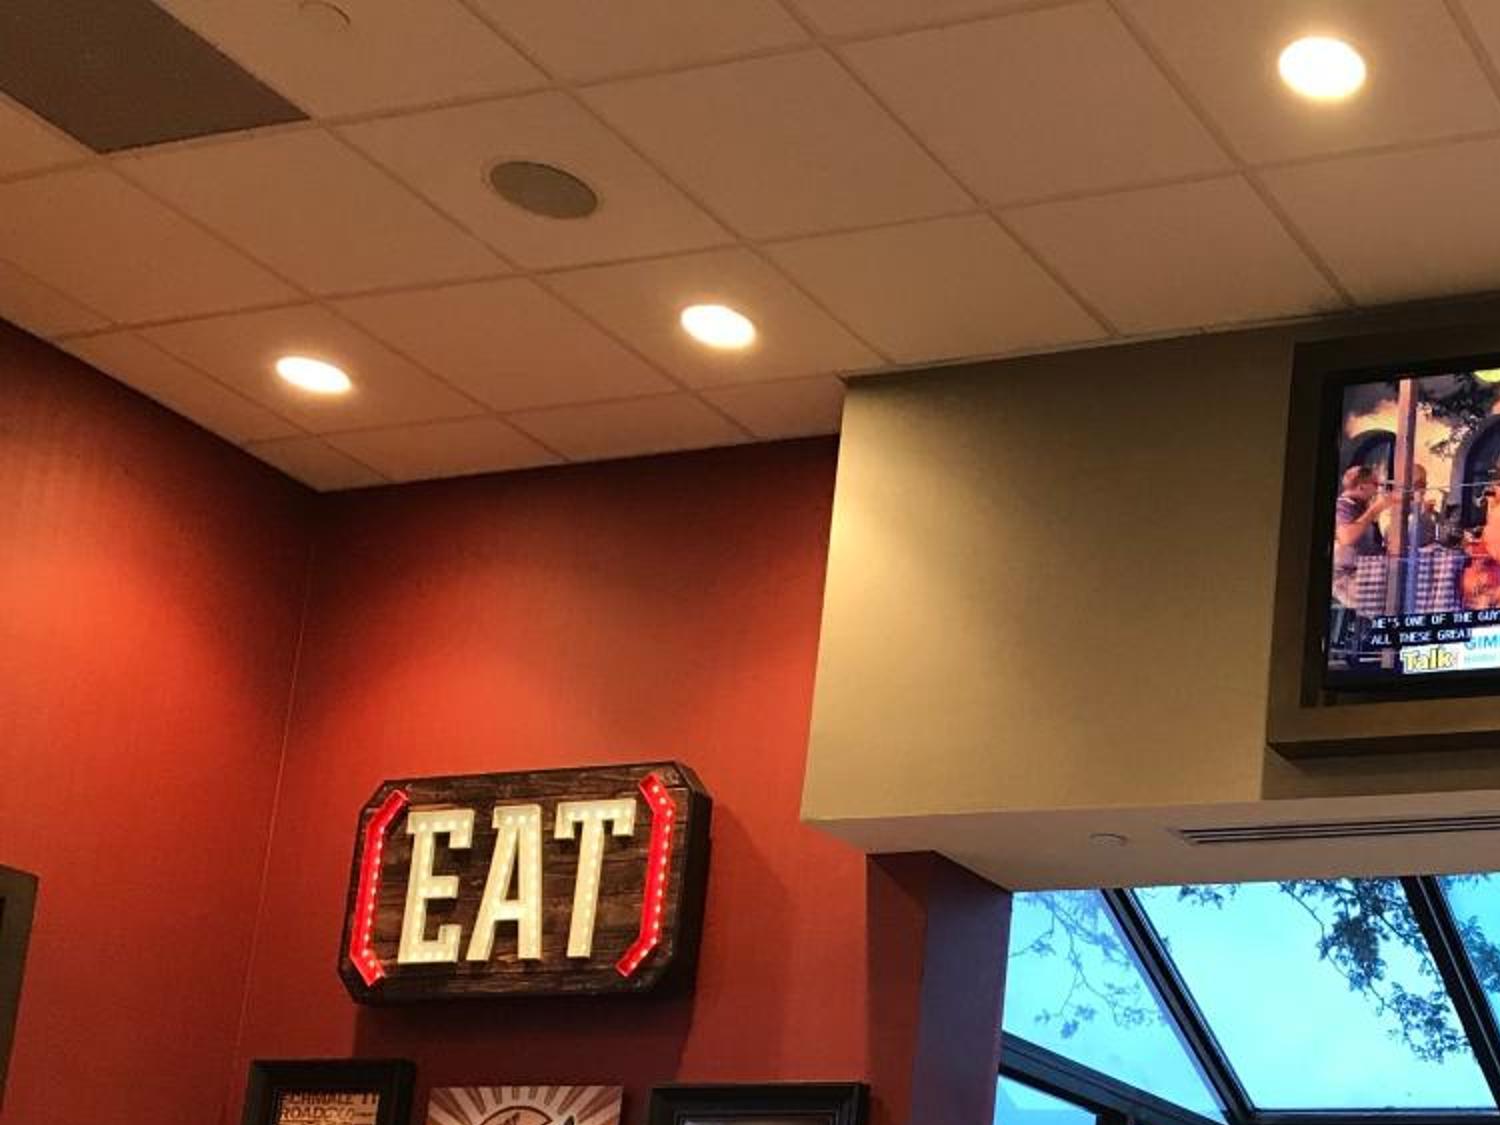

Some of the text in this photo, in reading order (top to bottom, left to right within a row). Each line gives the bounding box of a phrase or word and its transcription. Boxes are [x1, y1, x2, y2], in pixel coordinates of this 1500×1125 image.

[1372, 615, 1399, 629] HE'S
[1405, 614, 1425, 627] ONE
[1432, 612, 1446, 625] OF
[1453, 611, 1473, 624] THE
[1371, 627, 1472, 646] ALL THESE GREAT
[398, 798, 637, 964] EAT
